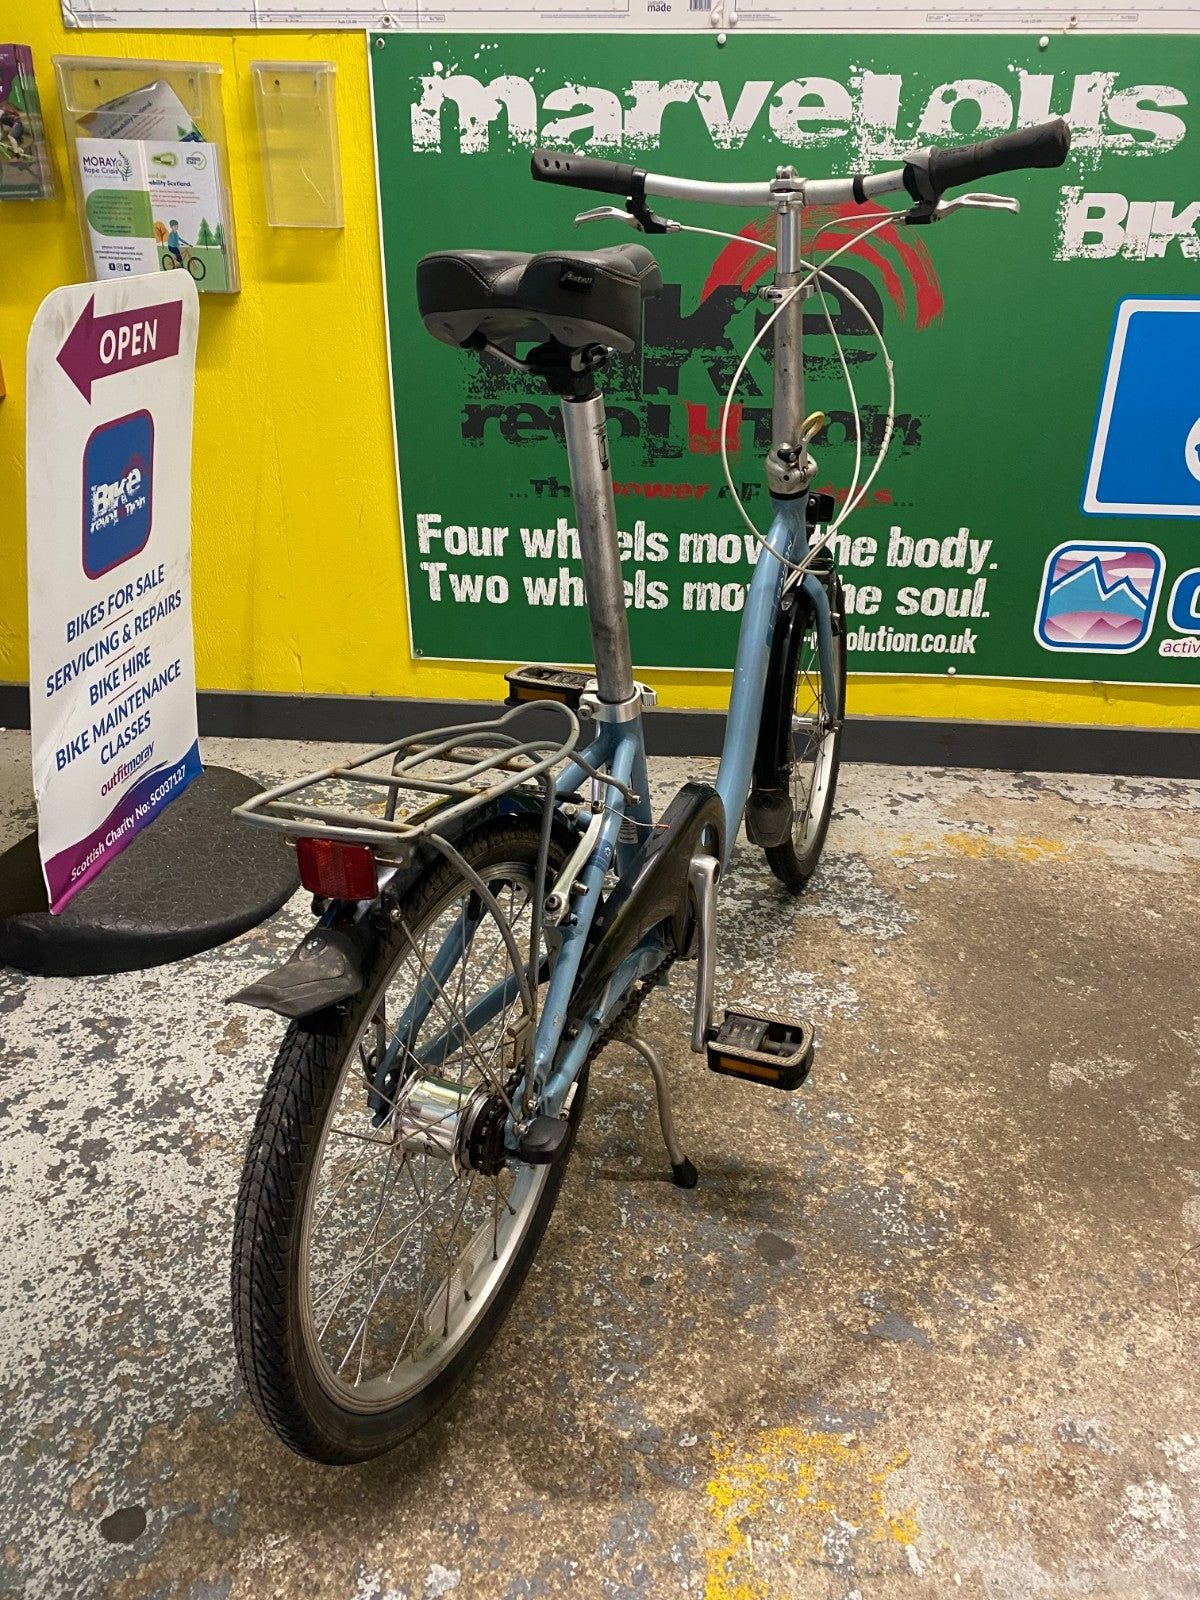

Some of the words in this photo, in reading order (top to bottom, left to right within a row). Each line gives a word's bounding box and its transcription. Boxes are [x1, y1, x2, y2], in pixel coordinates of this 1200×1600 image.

[647, 3, 672, 12] made
[82, 156, 117, 167] MORAY
[84, 166, 99, 174] Rape
[99, 318, 158, 365] OPEN
[416, 513, 509, 558] Four
[519, 517, 669, 562] whels
[679, 532, 768, 565] mov
[886, 526, 998, 575] body.
[67, 601, 105, 643] BIKES
[107, 583, 134, 615] FOR
[136, 564, 165, 597] SALE
[420, 561, 509, 604] Two
[522, 567, 669, 610] whels
[682, 581, 752, 612] mo
[838, 574, 882, 616] he
[895, 577, 990, 618] soul.
[46, 630, 120, 698] SERVICING
[122, 623, 132, 644] &
[134, 589, 181, 636] REPAIRS
[1163, 641, 1200, 653] activ
[89, 668, 121, 706] BIKE
[122, 645, 151, 682] HIRE
[55, 730, 90, 772] BIKE
[92, 659, 181, 743] MAINTENANCE
[100, 710, 151, 765] CLASSES
[101, 741, 154, 797] outfitmoray
[71, 842, 105, 882] Scottish
[105, 814, 135, 848] Charity
[134, 801, 151, 820] No:
[150, 765, 186, 806] SC037127
